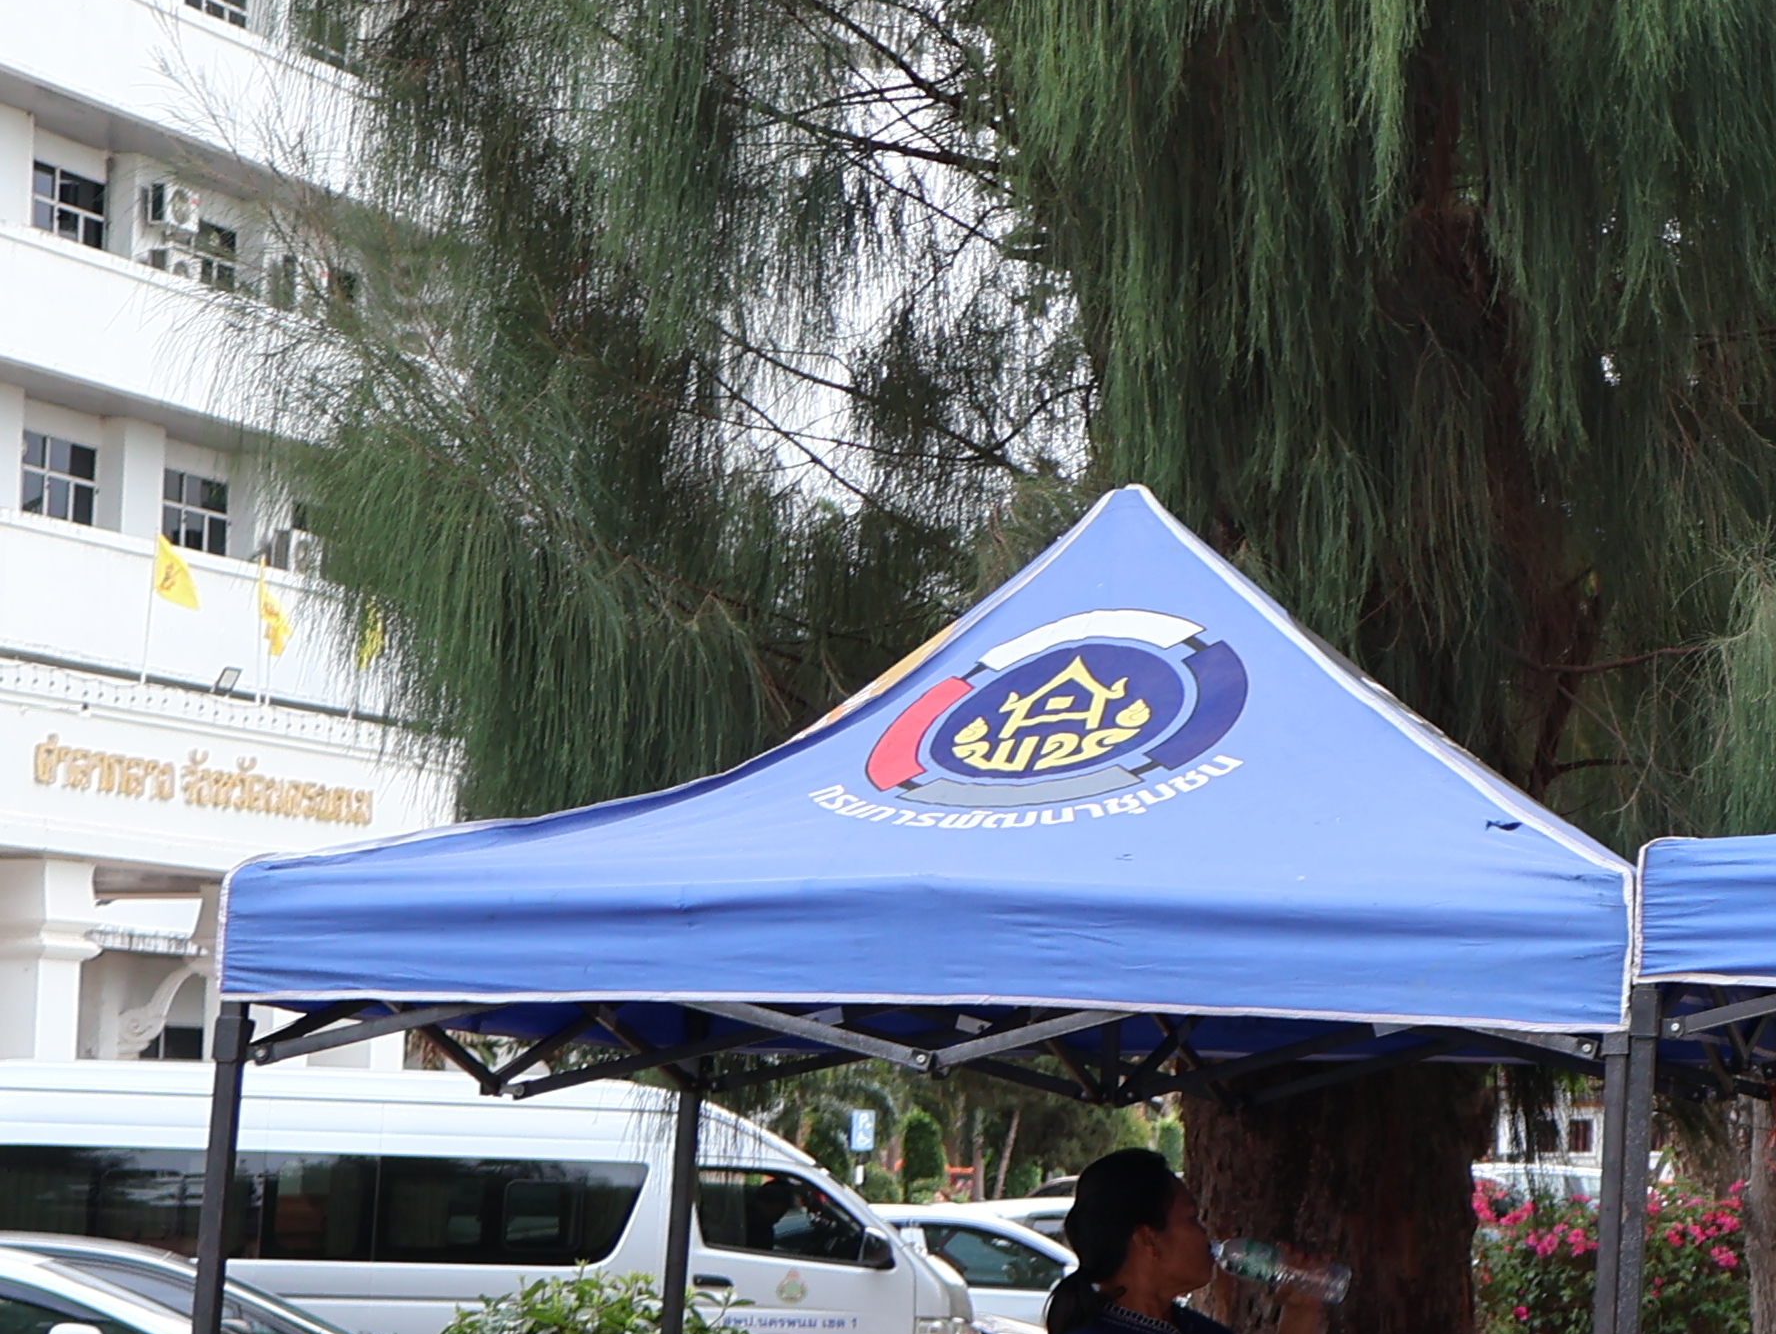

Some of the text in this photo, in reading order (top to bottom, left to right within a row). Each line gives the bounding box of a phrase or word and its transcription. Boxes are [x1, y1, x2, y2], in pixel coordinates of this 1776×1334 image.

[808, 755, 1244, 830] กรมการพัฒนาชุมชน
